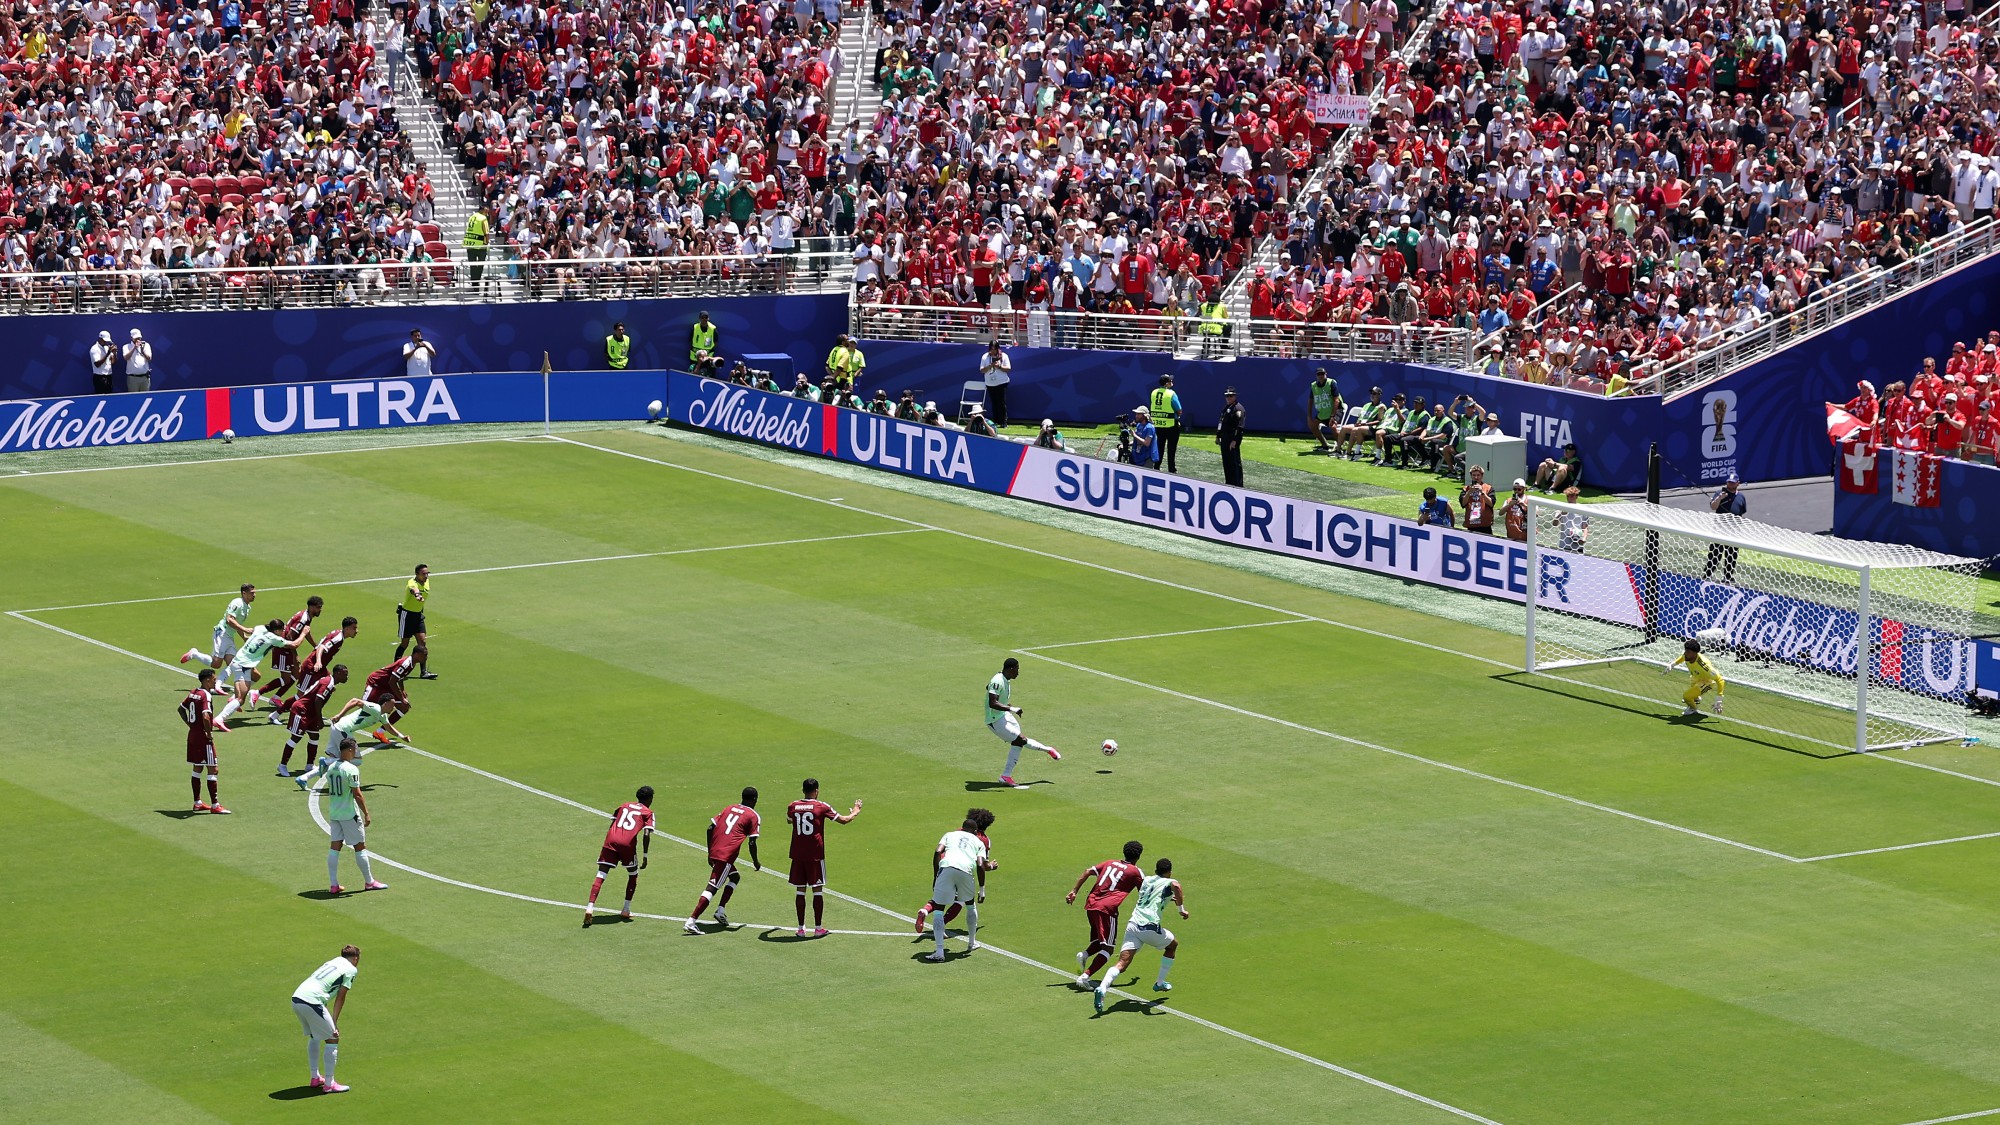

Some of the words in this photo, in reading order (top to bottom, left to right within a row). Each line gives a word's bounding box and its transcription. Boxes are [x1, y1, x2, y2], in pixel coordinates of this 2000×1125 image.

[1327, 107, 1355, 119] XHAKA
[970, 315, 988, 325] 123
[1374, 332, 1392, 342] 124
[0, 395, 187, 450] Michelob
[254, 378, 461, 433] ULTRA
[689, 378, 812, 449] Michelob
[850, 413, 976, 484] ULTRA
[1521, 412, 1573, 449] FIFA
[1711, 444, 1727, 453] FIFA
[1701, 460, 1723, 469] WORLD
[1701, 466, 1737, 480] 2026
[1054, 459, 1274, 543] SUPERIOR
[1286, 503, 1430, 572] LIGHT
[1441, 533, 1571, 604] BEER
[1685, 582, 1860, 672] Michelob
[1922, 632, 2000, 701] UL
[190, 701, 196, 723] 8
[329, 774, 343, 796] 10
[617, 807, 642, 831] 15
[725, 813, 740, 835] 4
[794, 811, 814, 835] 16
[1099, 865, 1124, 892] 14
